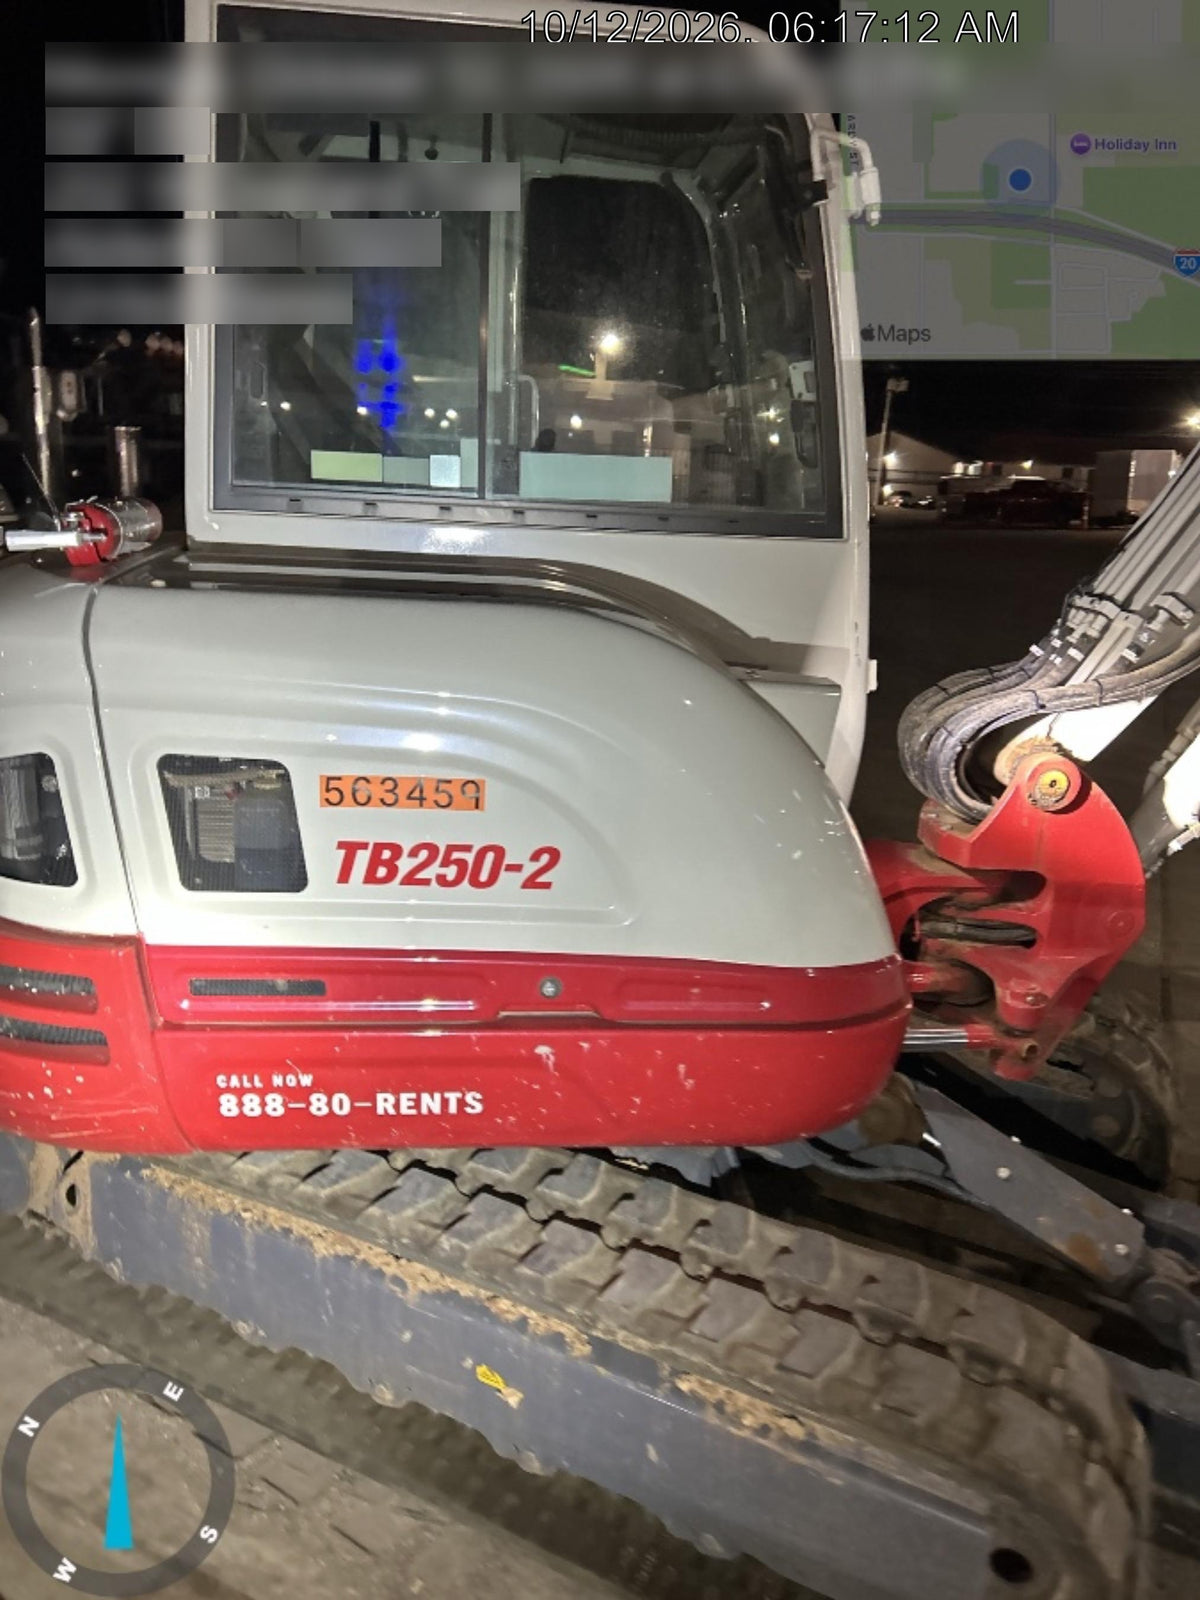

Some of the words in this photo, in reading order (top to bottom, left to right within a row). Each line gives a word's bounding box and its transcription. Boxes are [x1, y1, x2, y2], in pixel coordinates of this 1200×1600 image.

[323, 775, 481, 810] 563459
[335, 840, 561, 890] TB250-2
[216, 1074, 264, 1089] CALL
[271, 1074, 314, 1088] NOW
[218, 1090, 484, 1118] 888-80-RENTS
